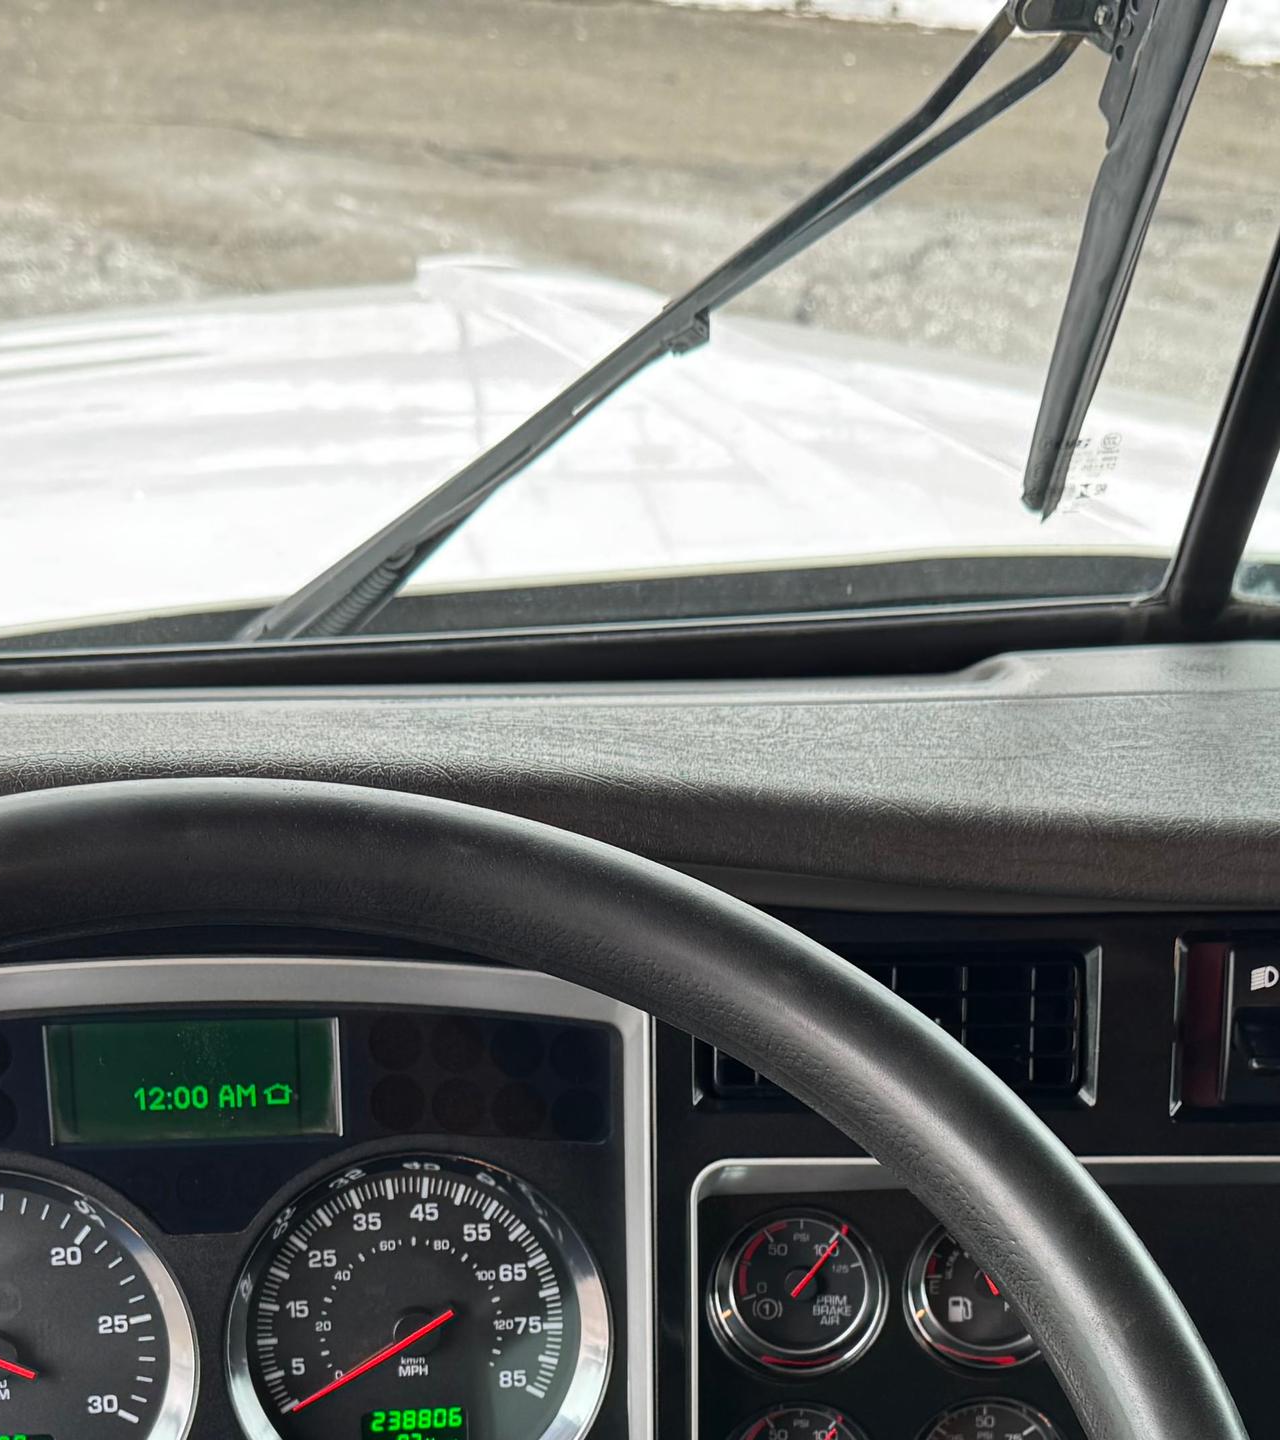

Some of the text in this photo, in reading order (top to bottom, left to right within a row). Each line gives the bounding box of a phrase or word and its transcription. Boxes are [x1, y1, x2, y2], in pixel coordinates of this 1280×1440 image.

[133, 1084, 257, 1111] 12:00 AM
[410, 1203, 439, 1222] 45
[353, 1212, 382, 1231] 35
[463, 1223, 491, 1243] 55
[379, 1239, 396, 1251] 60
[433, 1239, 450, 1251] 80
[768, 1243, 788, 1257] 50
[50, 1246, 82, 1267] 20
[308, 1250, 337, 1268] 25
[334, 1270, 351, 1282] 40
[475, 1270, 496, 1281] 100
[498, 1263, 527, 1282] 65
[756, 1281, 768, 1294] 0
[929, 1279, 940, 1295] E
[286, 1300, 309, 1318] 15
[812, 1305, 852, 1317] BRAKE
[98, 1314, 129, 1334] 25
[315, 1320, 332, 1332] 20
[493, 1319, 514, 1331] 120
[514, 1316, 542, 1334] 75
[820, 1315, 840, 1326] AIR
[291, 1358, 306, 1376] 5
[398, 1365, 429, 1377] MPH
[499, 1369, 527, 1389] 85
[87, 1394, 118, 1415] 30
[370, 1406, 462, 1433] 238806
[975, 1415, 995, 1428] 50
[768, 1429, 788, 1440] 50
